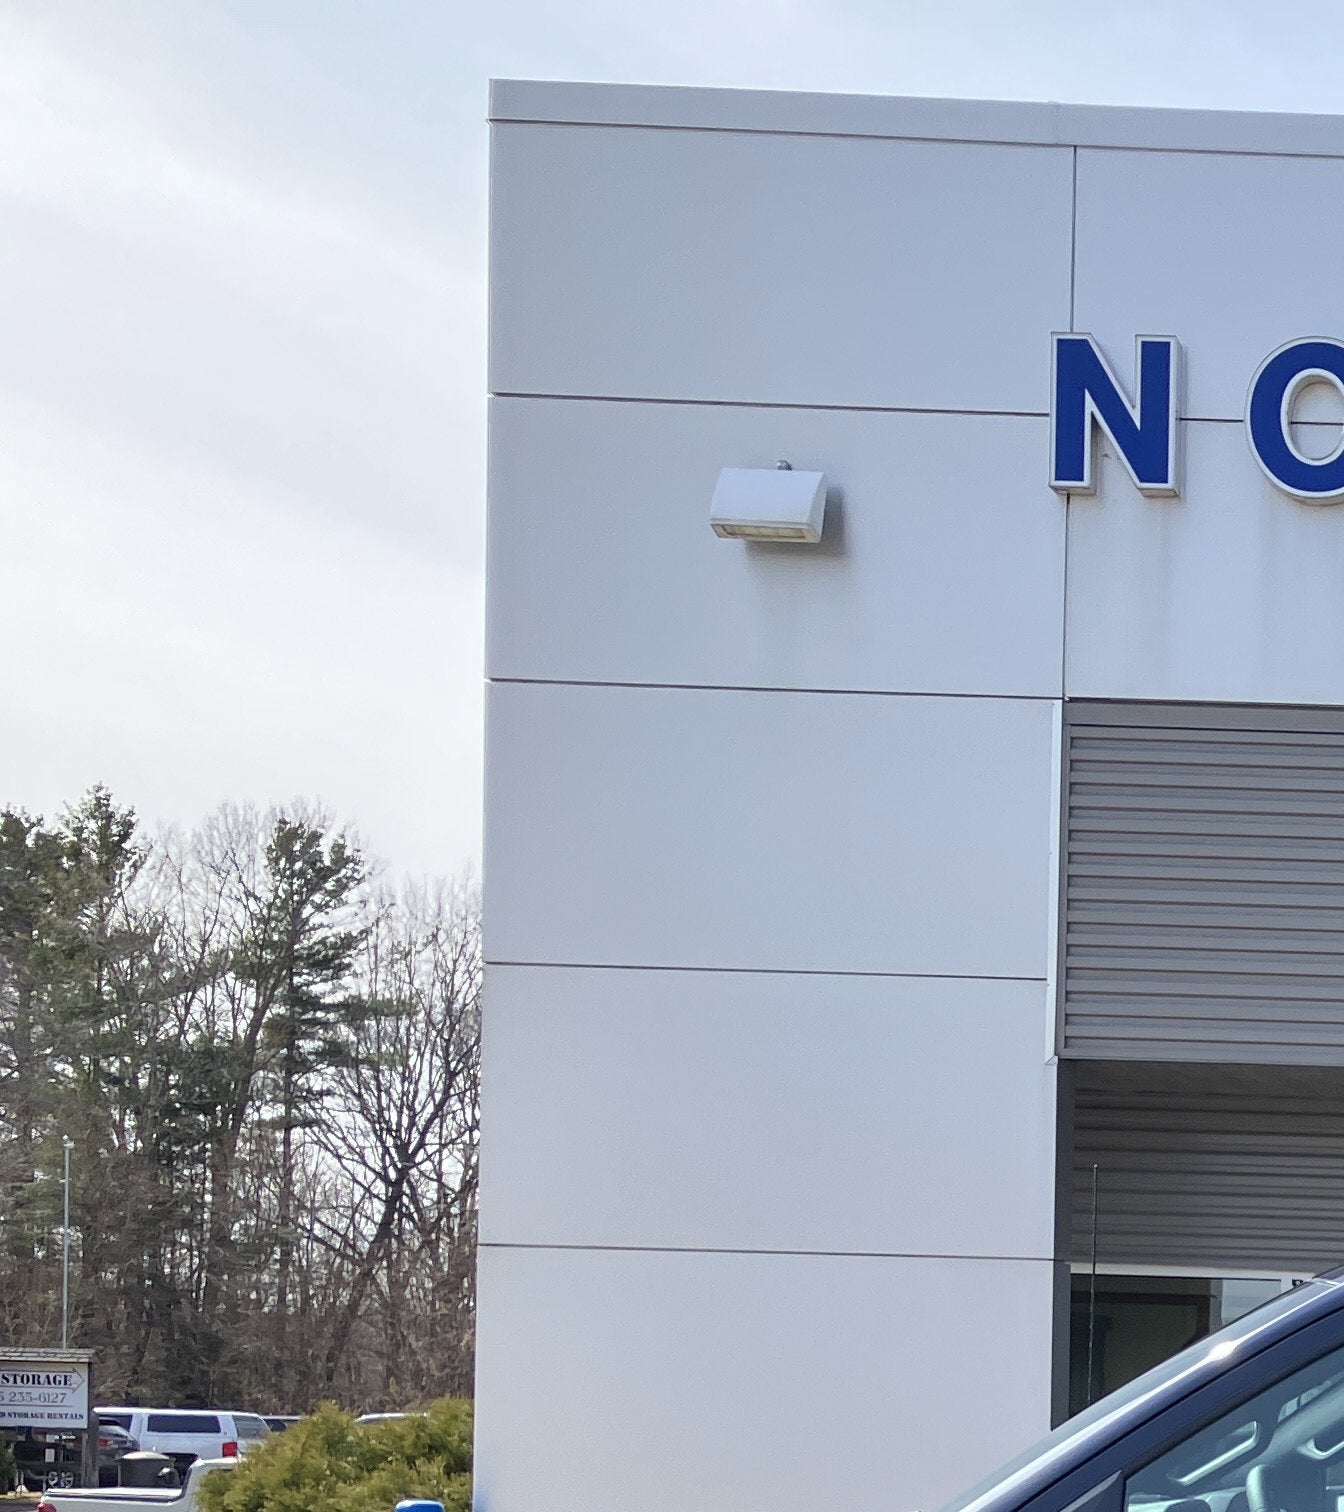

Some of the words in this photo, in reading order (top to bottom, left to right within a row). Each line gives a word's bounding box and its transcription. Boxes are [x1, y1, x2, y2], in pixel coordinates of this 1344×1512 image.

[1, 1373, 73, 1386] STORAGE
[8, 1411, 46, 1419] STORAGE
[47, 1412, 84, 1420] RENTALS
